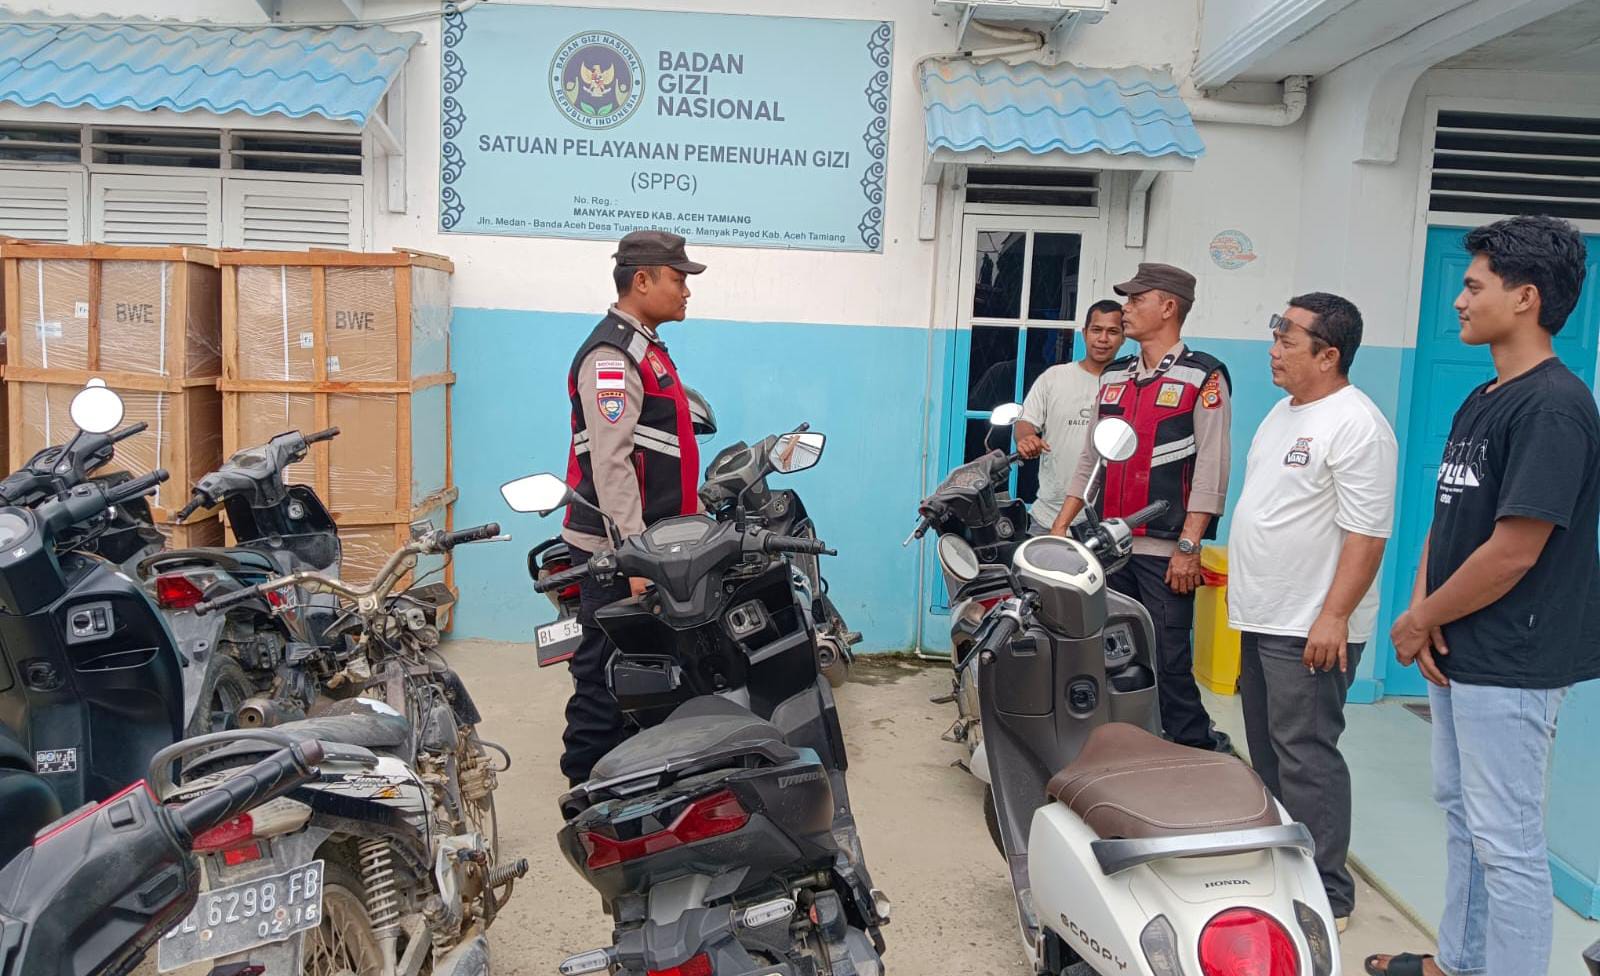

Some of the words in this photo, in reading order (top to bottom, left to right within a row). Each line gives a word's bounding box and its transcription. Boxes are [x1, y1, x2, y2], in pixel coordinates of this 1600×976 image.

[556, 41, 579, 69] BADAN
[581, 35, 600, 44] GIZI
[603, 36, 639, 72] NASIONAL
[658, 51, 744, 74] BADAN
[658, 73, 708, 95] GIZI
[556, 89, 592, 125] REPUBLIK
[595, 94, 638, 126] INDONESIA
[657, 96, 785, 121] NASIONAL
[479, 134, 557, 155] SATUAN
[563, 138, 679, 161] PELAYANAN
[684, 144, 807, 167] PEMENUHAN
[812, 150, 850, 169] GIZI
[631, 171, 697, 197] (SPPG)
[574, 196, 588, 205] No.
[591, 197, 612, 207] Reg.
[573, 208, 616, 218] MANYAK
[617, 209, 650, 219] PAYED
[651, 211, 675, 221] KAB.
[677, 213, 705, 222] ACEH
[707, 214, 752, 224] TAMIANG
[477, 217, 492, 226] Jln.
[495, 217, 526, 227] Medan
[533, 218, 562, 229] Banda
[564, 220, 586, 230] Aceh
[588, 222, 612, 232] Desa
[674, 225, 694, 235] Kec.
[696, 227, 730, 238] Manyak
[732, 228, 760, 239] Payed
[762, 229, 782, 239] Kab.
[783, 231, 807, 241] Aceh
[809, 232, 846, 243] Tamiang
[116, 304, 154, 323] BWE
[335, 310, 375, 331] BWE
[1287, 452, 1308, 465] VANS
[540, 630, 556, 644] BL
[1204, 879, 1251, 888] HONDA
[207, 882, 277, 926] 6298
[288, 868, 318, 905] FB
[1060, 911, 1127, 970] SCOOPY
